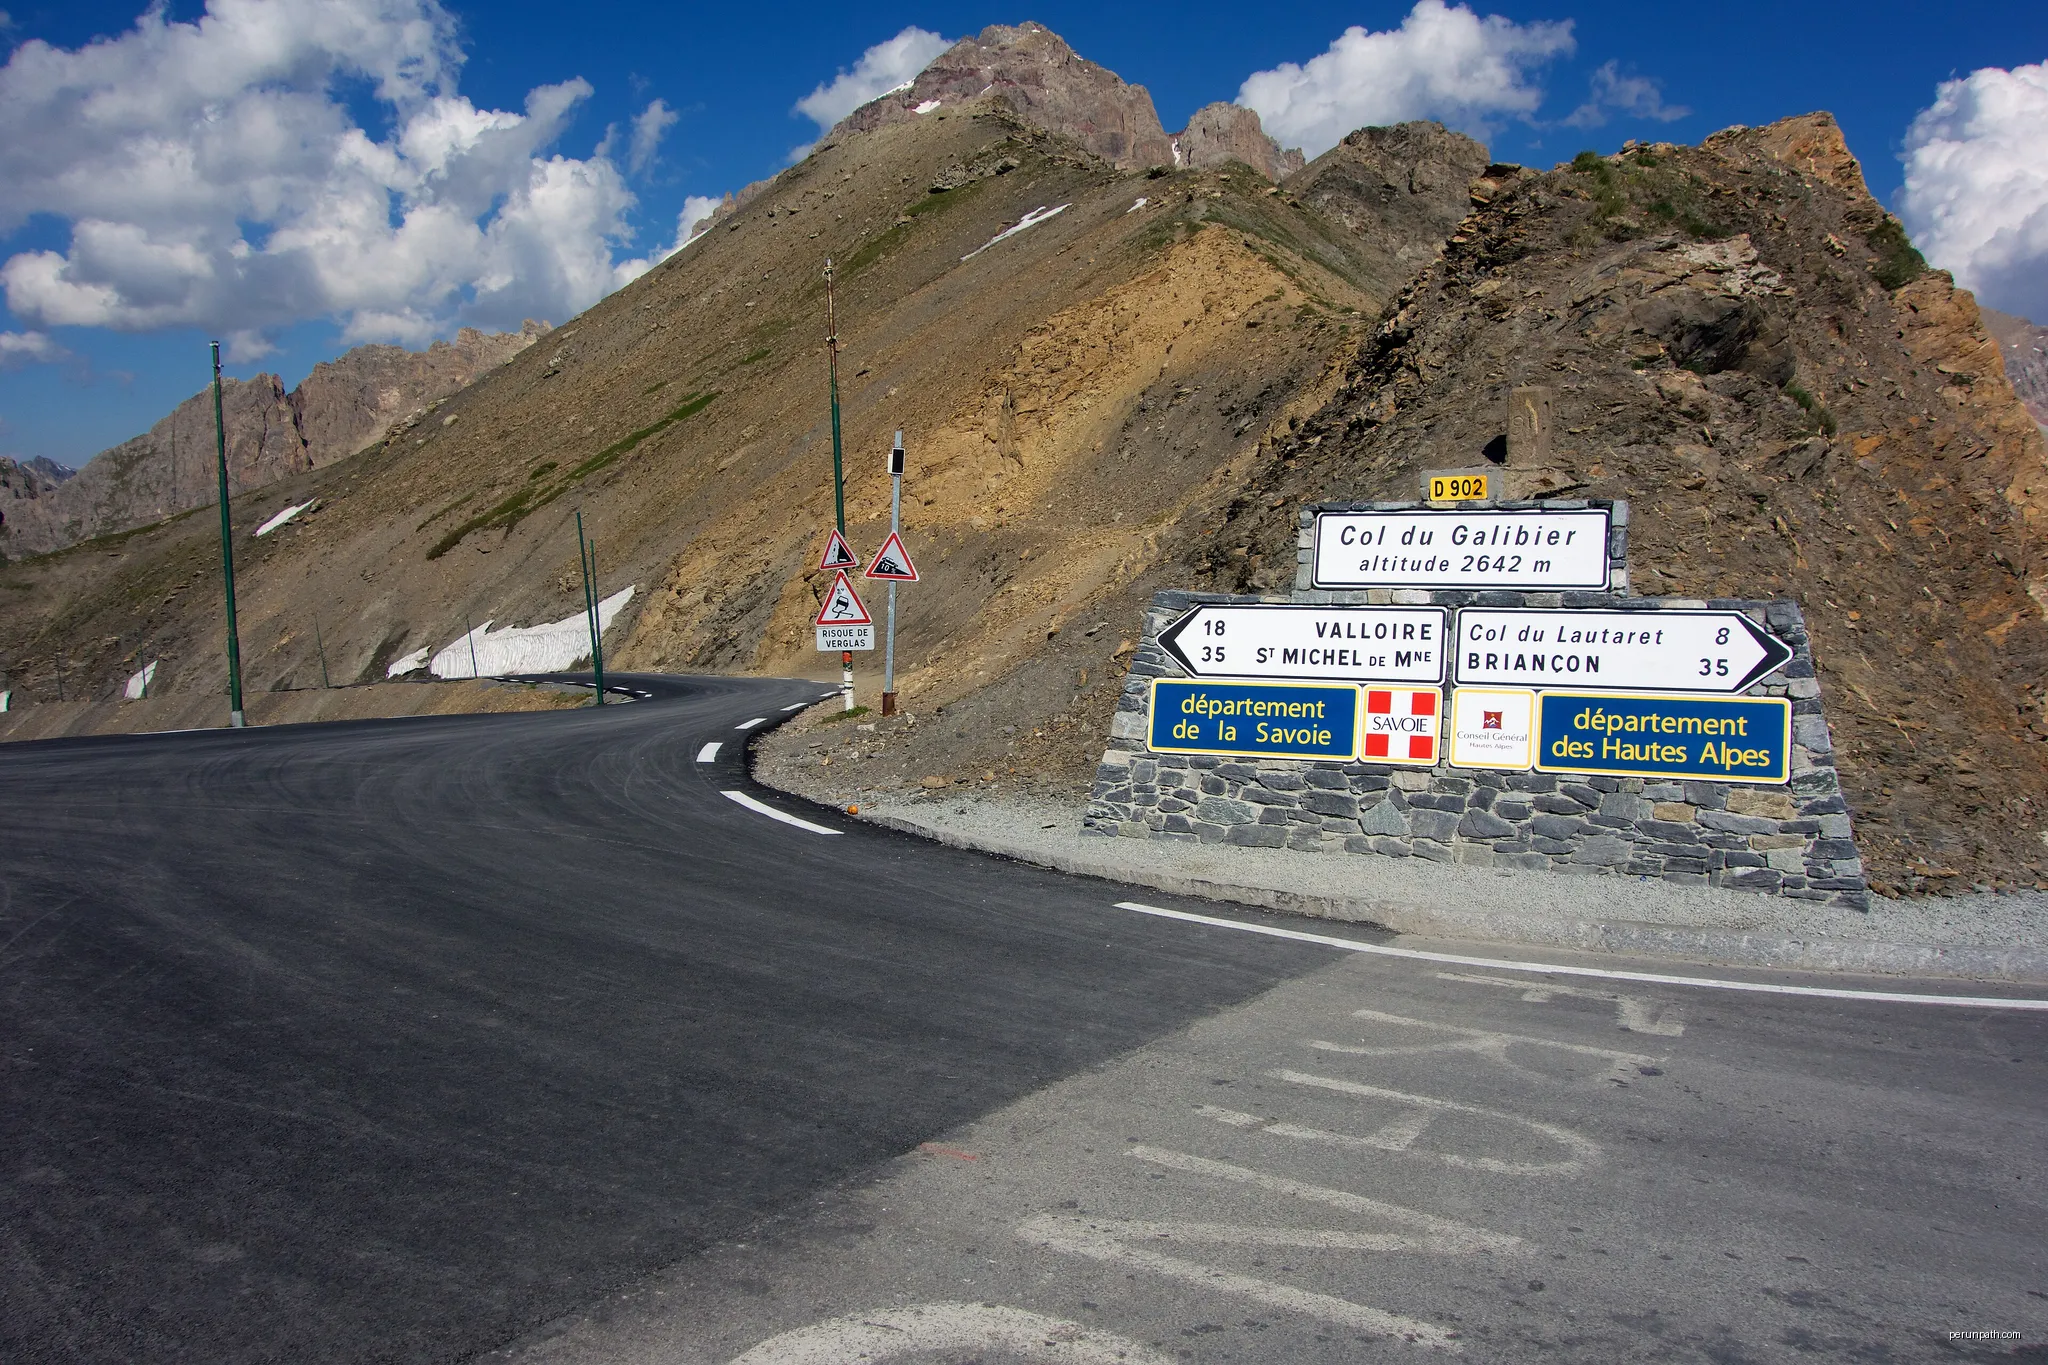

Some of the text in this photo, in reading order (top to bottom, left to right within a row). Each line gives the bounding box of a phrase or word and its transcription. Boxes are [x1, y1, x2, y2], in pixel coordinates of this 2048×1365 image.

[1434, 478, 1485, 497] D 902
[1340, 524, 1577, 546] Col du Galibier
[881, 563, 890, 571] 10
[1359, 554, 1551, 573] altitude 2642 m
[822, 628, 869, 638] RISQUE DE
[1204, 619, 1432, 641] 18 VALLOIRE
[1469, 623, 1731, 646] Col du Lautaret 8
[825, 638, 866, 648] VERGLAS
[1201, 645, 1226, 663] 35
[1282, 647, 1362, 667] MICHEL
[1369, 655, 1386, 667] DE
[1467, 652, 1729, 677] BRIANÇON 35
[1181, 693, 1326, 719] département
[1172, 718, 1332, 746] de la Savoie
[1372, 716, 1428, 733] SAVOIE
[1573, 707, 1749, 737] département
[1456, 730, 1528, 742] Conseil Général
[1551, 735, 1771, 771] des Hautes Alpes
